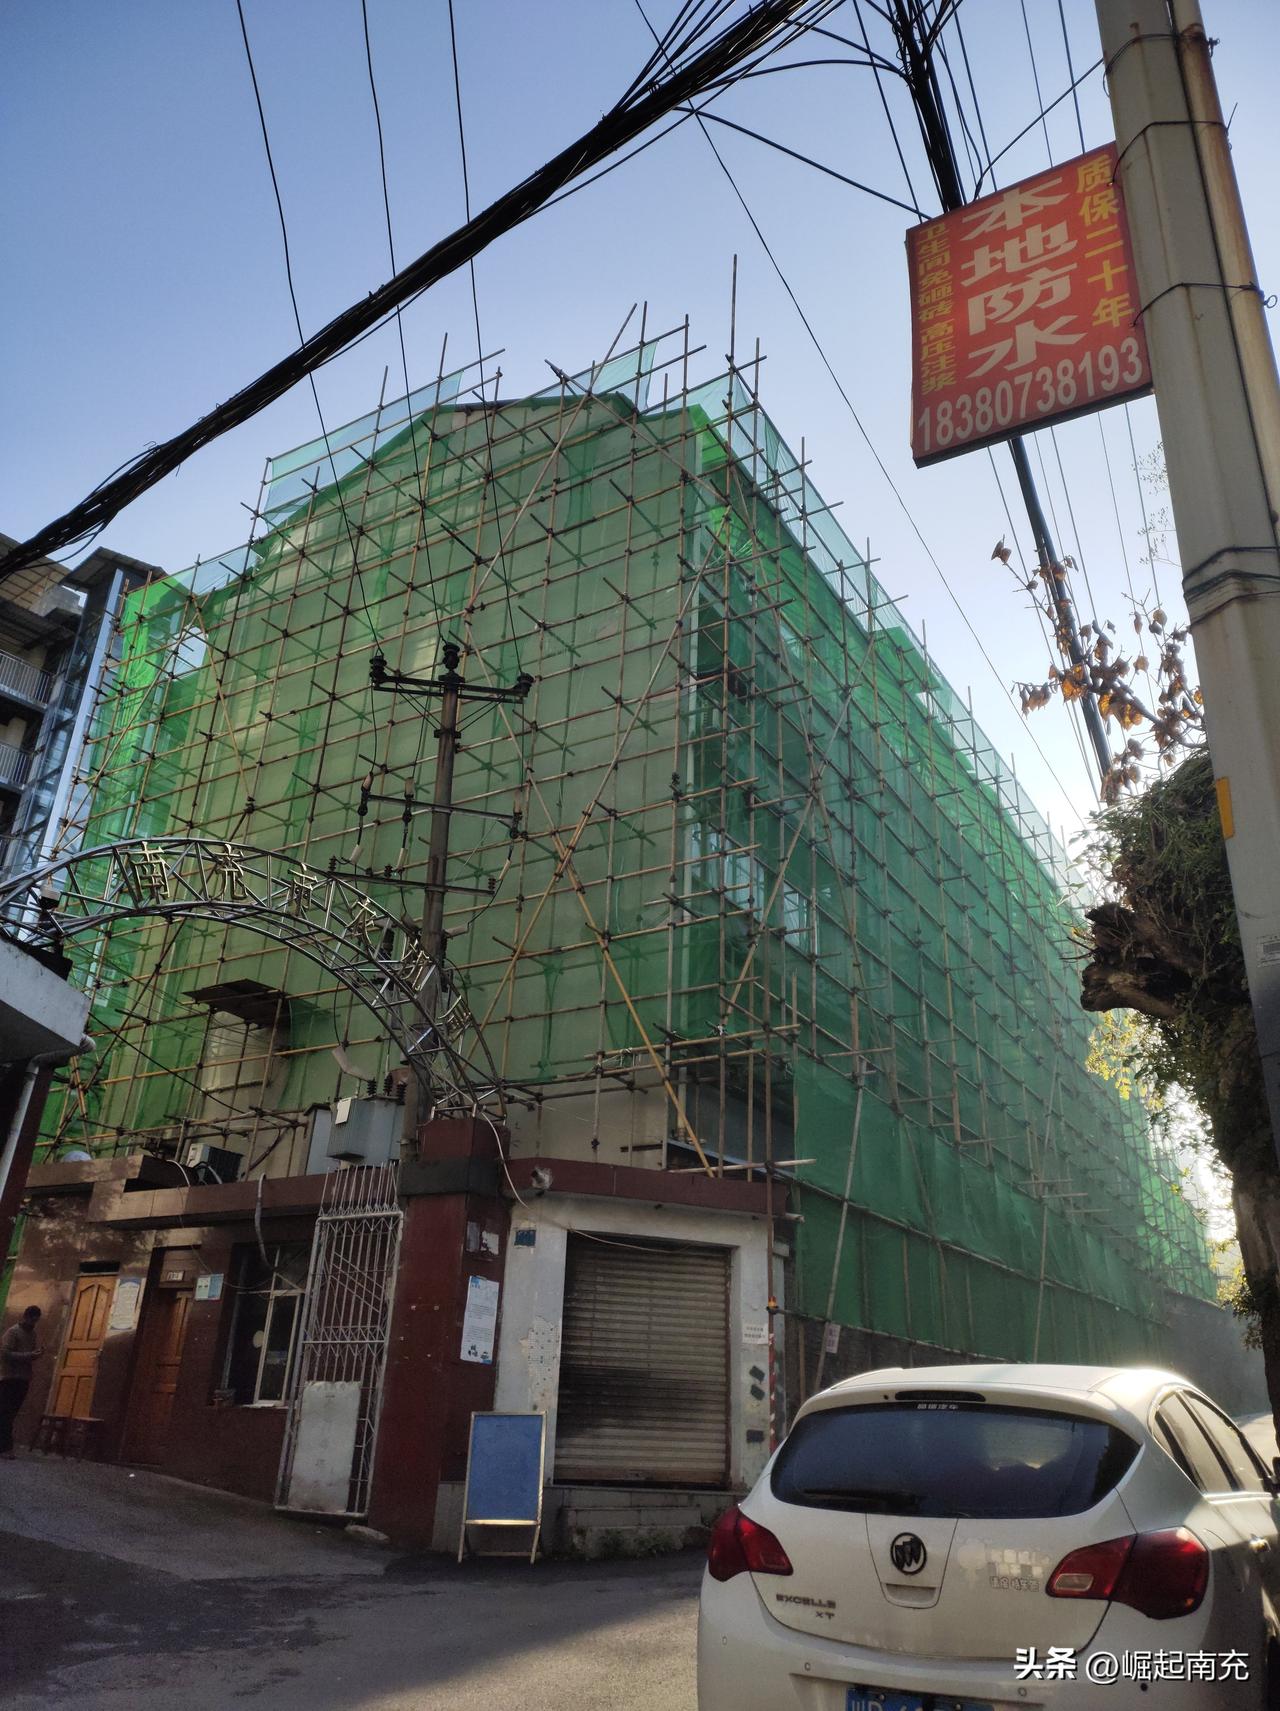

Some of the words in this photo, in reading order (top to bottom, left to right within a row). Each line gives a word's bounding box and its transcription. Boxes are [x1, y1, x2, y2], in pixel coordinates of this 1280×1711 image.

[960, 177, 1087, 378] 本地防水
[1077, 154, 1135, 328] 质保二十年
[917, 337, 1143, 450] 18380738193
[776, 1593, 837, 1609] EXCELLE
[815, 1611, 835, 1620] XT
